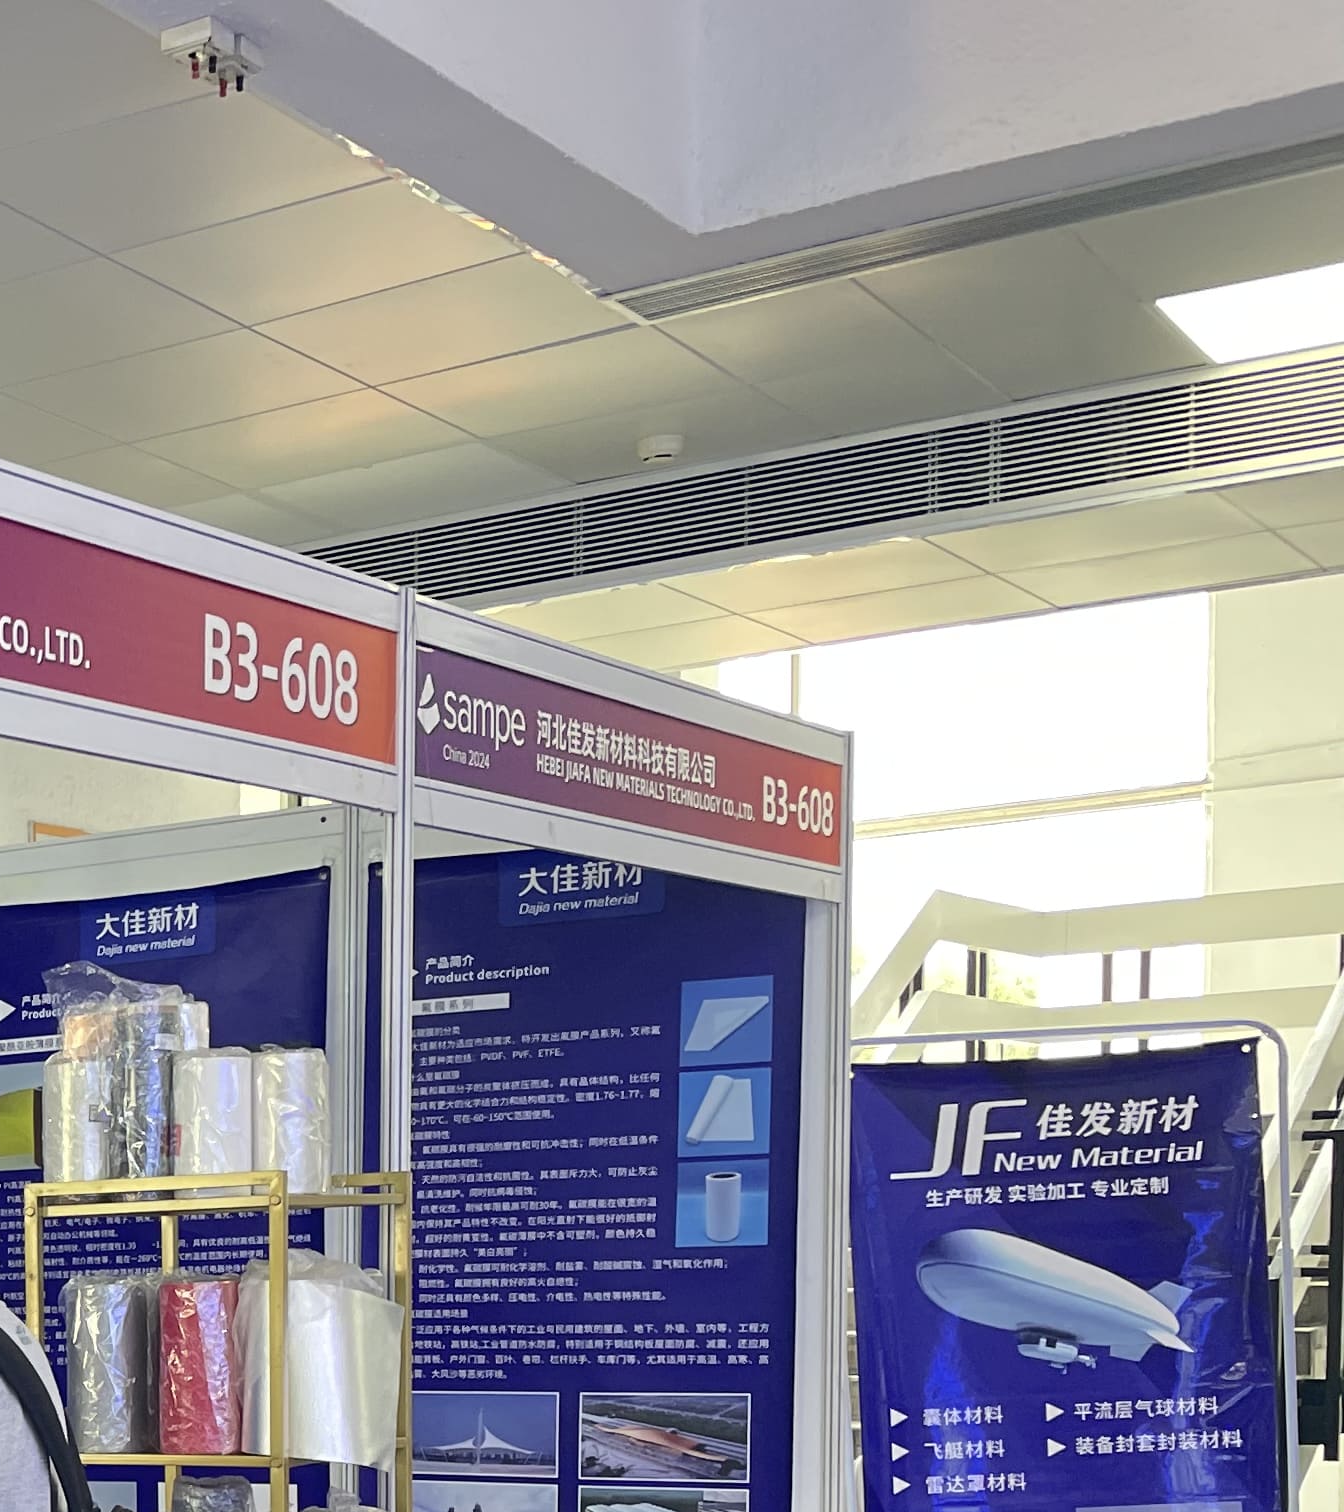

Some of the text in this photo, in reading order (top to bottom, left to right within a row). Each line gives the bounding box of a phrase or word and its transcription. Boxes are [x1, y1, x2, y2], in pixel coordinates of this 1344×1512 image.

[203, 612, 359, 726] B3-608
[443, 690, 527, 751] sampe
[442, 743, 490, 770] China 2024
[536, 709, 716, 788] 河北佳发新材料科技有限公司
[536, 753, 756, 822] HEBEI JIAFA NEW MATERIALS TECHNOLOGY CO.,LTD.
[762, 776, 834, 837] B3-608
[518, 860, 644, 897] 大佳新材
[518, 891, 639, 916] Dajia new material
[95, 902, 200, 940] 大佳新材
[96, 934, 195, 958] Dajia new material
[425, 954, 475, 970] 产品简介
[425, 963, 551, 985] Product description
[1035, 1094, 1200, 1141] 佳发新材
[889, 1098, 1028, 1181] JF
[993, 1140, 1205, 1174] New Material
[925, 1176, 1169, 1208] 生产研发 实验加工 专业定制
[922, 1405, 1004, 1427] 囊体材料
[1073, 1395, 1219, 1421] 平流层气球材料
[923, 1439, 1006, 1460] 飞艇材料
[1074, 1428, 1244, 1456] 装备封套封装材料
[925, 1472, 1027, 1495] 雷达罩材料
